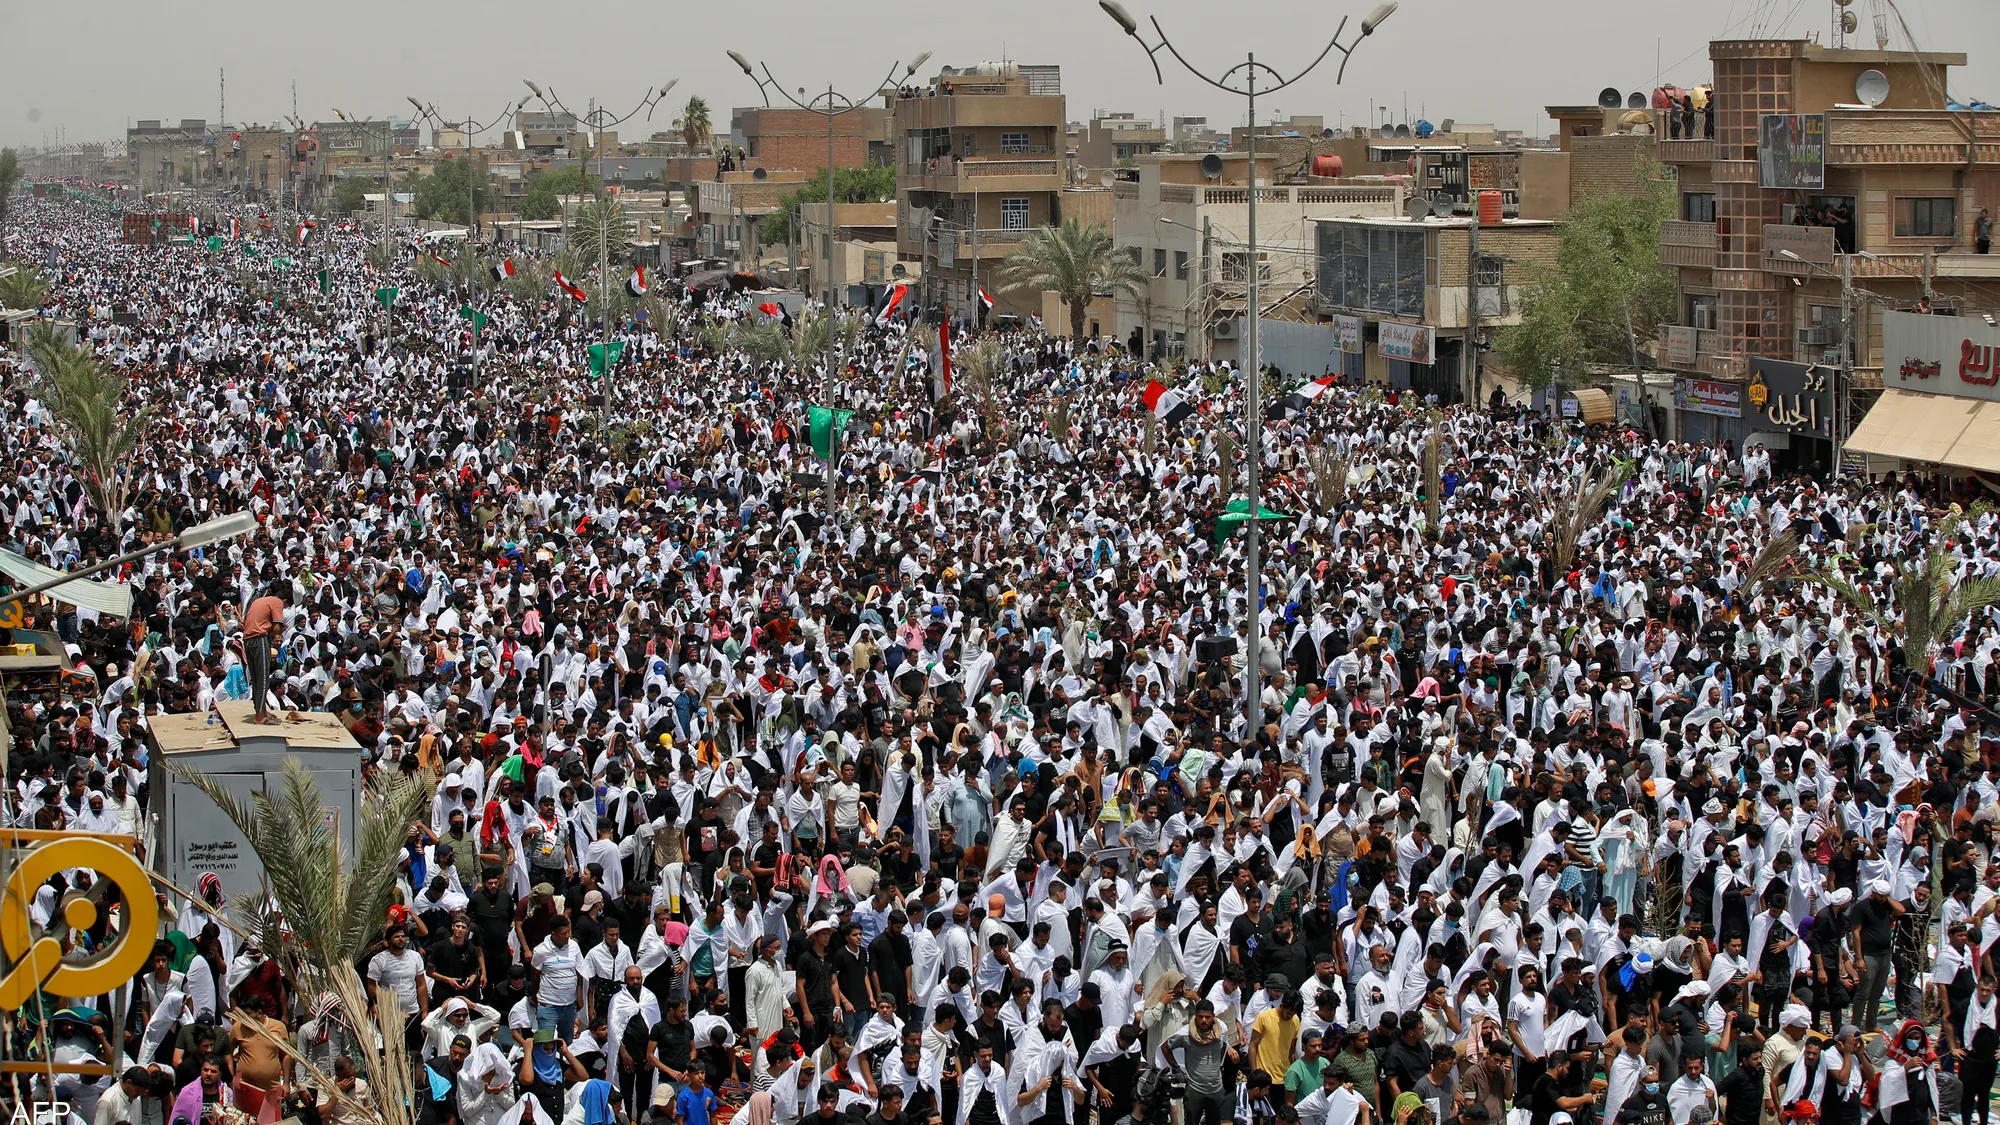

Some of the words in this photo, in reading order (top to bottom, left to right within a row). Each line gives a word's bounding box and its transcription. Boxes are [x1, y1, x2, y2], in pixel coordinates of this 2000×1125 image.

[189, 842, 207, 851] رسول
[219, 841, 237, 850] مكتب
[1643, 1113, 1664, 1124] NIKE
